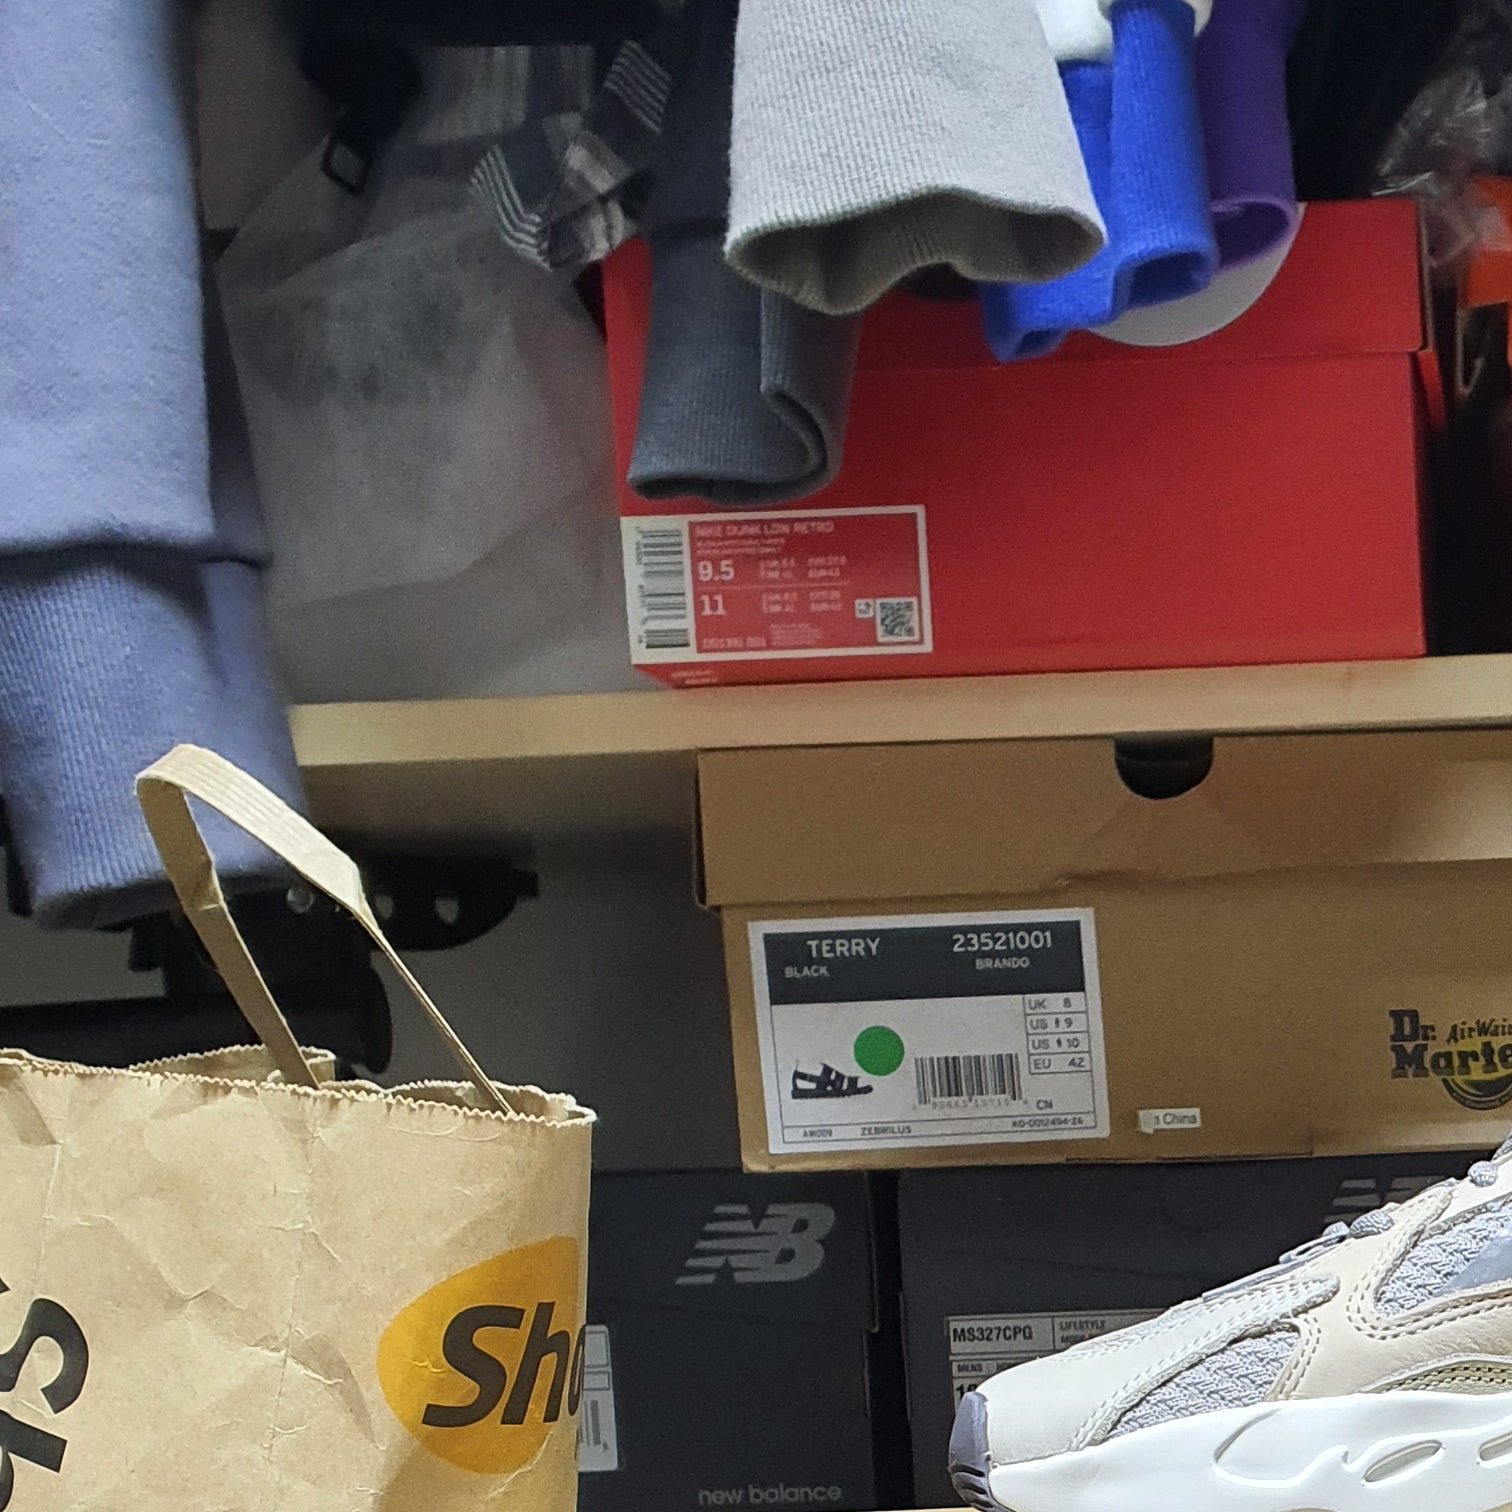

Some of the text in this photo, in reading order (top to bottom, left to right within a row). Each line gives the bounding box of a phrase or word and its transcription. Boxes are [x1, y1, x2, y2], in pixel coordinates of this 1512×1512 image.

[763, 523, 790, 535] LOW
[793, 521, 834, 534] RETRO
[697, 558, 735, 582] 9.5
[699, 593, 727, 616] 11
[807, 930, 1053, 959] TERRY 23521001
[784, 956, 1031, 979] BLACK BRANDO
[1028, 997, 1072, 1010] UK 8
[1030, 1017, 1073, 1030] US 9
[1389, 1008, 1437, 1043] Dr.
[1031, 1037, 1080, 1050] US 10
[1033, 1057, 1085, 1070] EU 42
[1162, 1112, 1197, 1125] China
[697, 1481, 842, 1507] new balance
